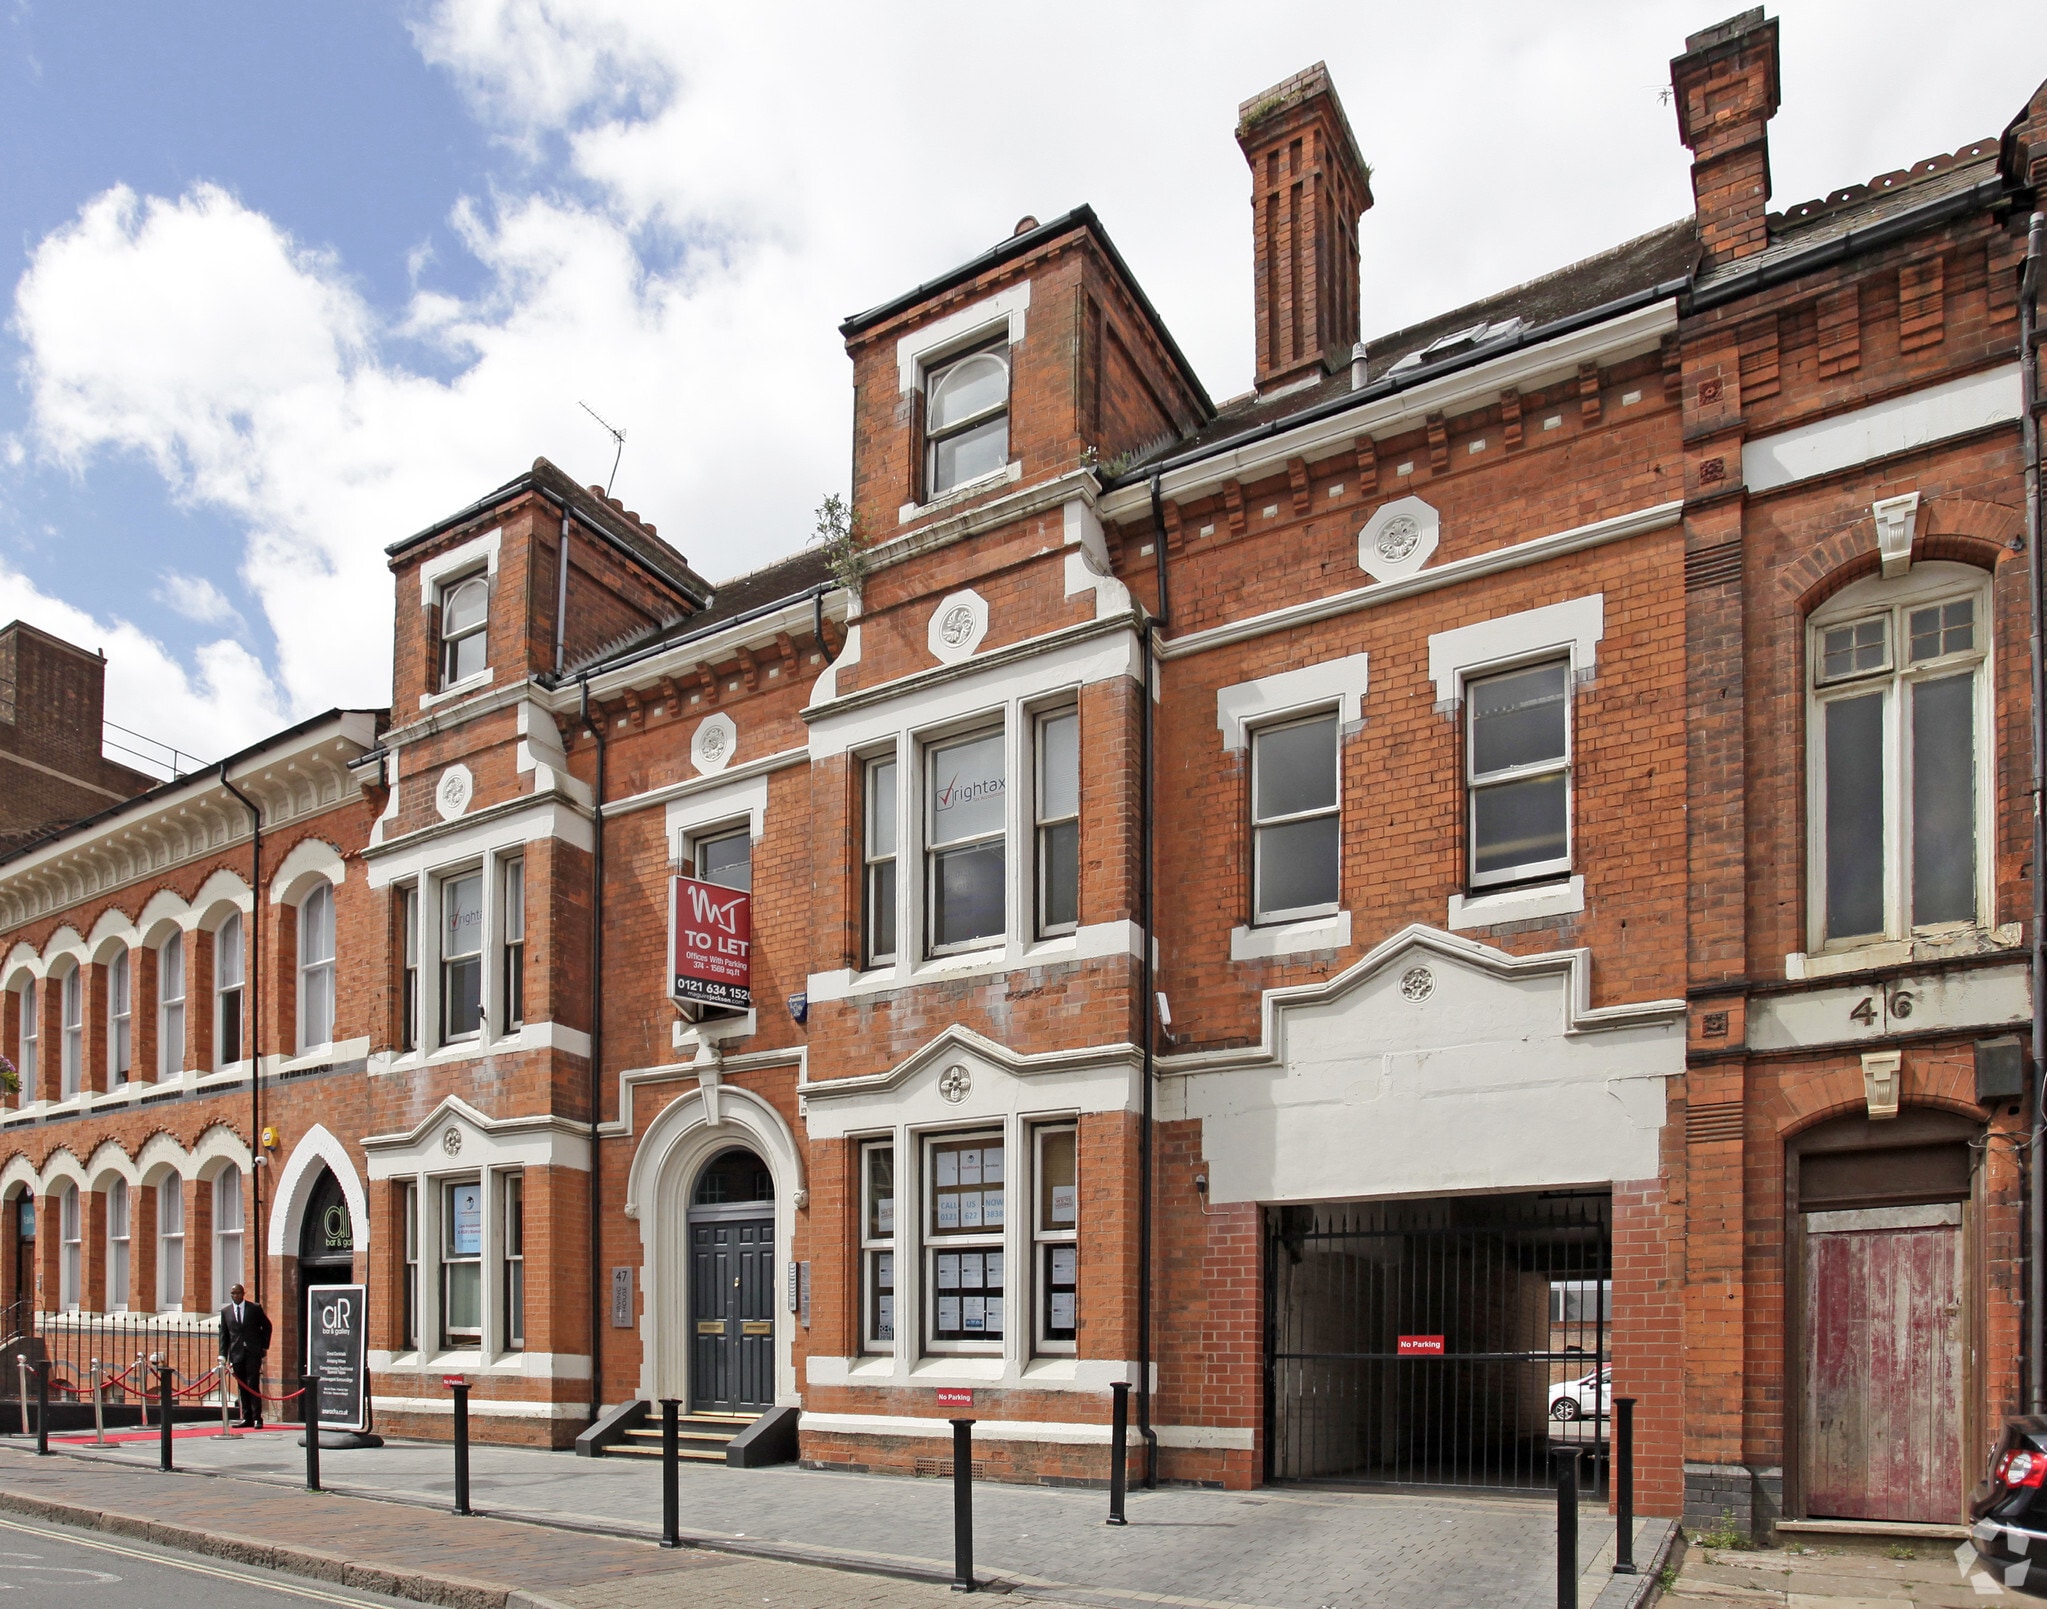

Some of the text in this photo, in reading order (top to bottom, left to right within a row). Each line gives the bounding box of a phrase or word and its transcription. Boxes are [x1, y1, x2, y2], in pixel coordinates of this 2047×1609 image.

[953, 776, 1006, 803] rightax
[684, 929, 749, 957] TO LET
[686, 951, 748, 971] Offices With Parking
[693, 960, 705, 970] 374
[677, 978, 703, 992] 0121
[706, 983, 727, 997] 634
[687, 990, 745, 1006] maguirejackson.com
[1850, 990, 1914, 1027] 46
[940, 1198, 1004, 1210] CALL US NOW
[940, 1210, 1004, 1221] 0121 622 3838
[325, 1238, 336, 1247] bar
[616, 1270, 628, 1282] 47
[334, 1328, 351, 1336] gallery
[1412, 1341, 1441, 1350] Parking
[948, 1394, 971, 1402] Parking
